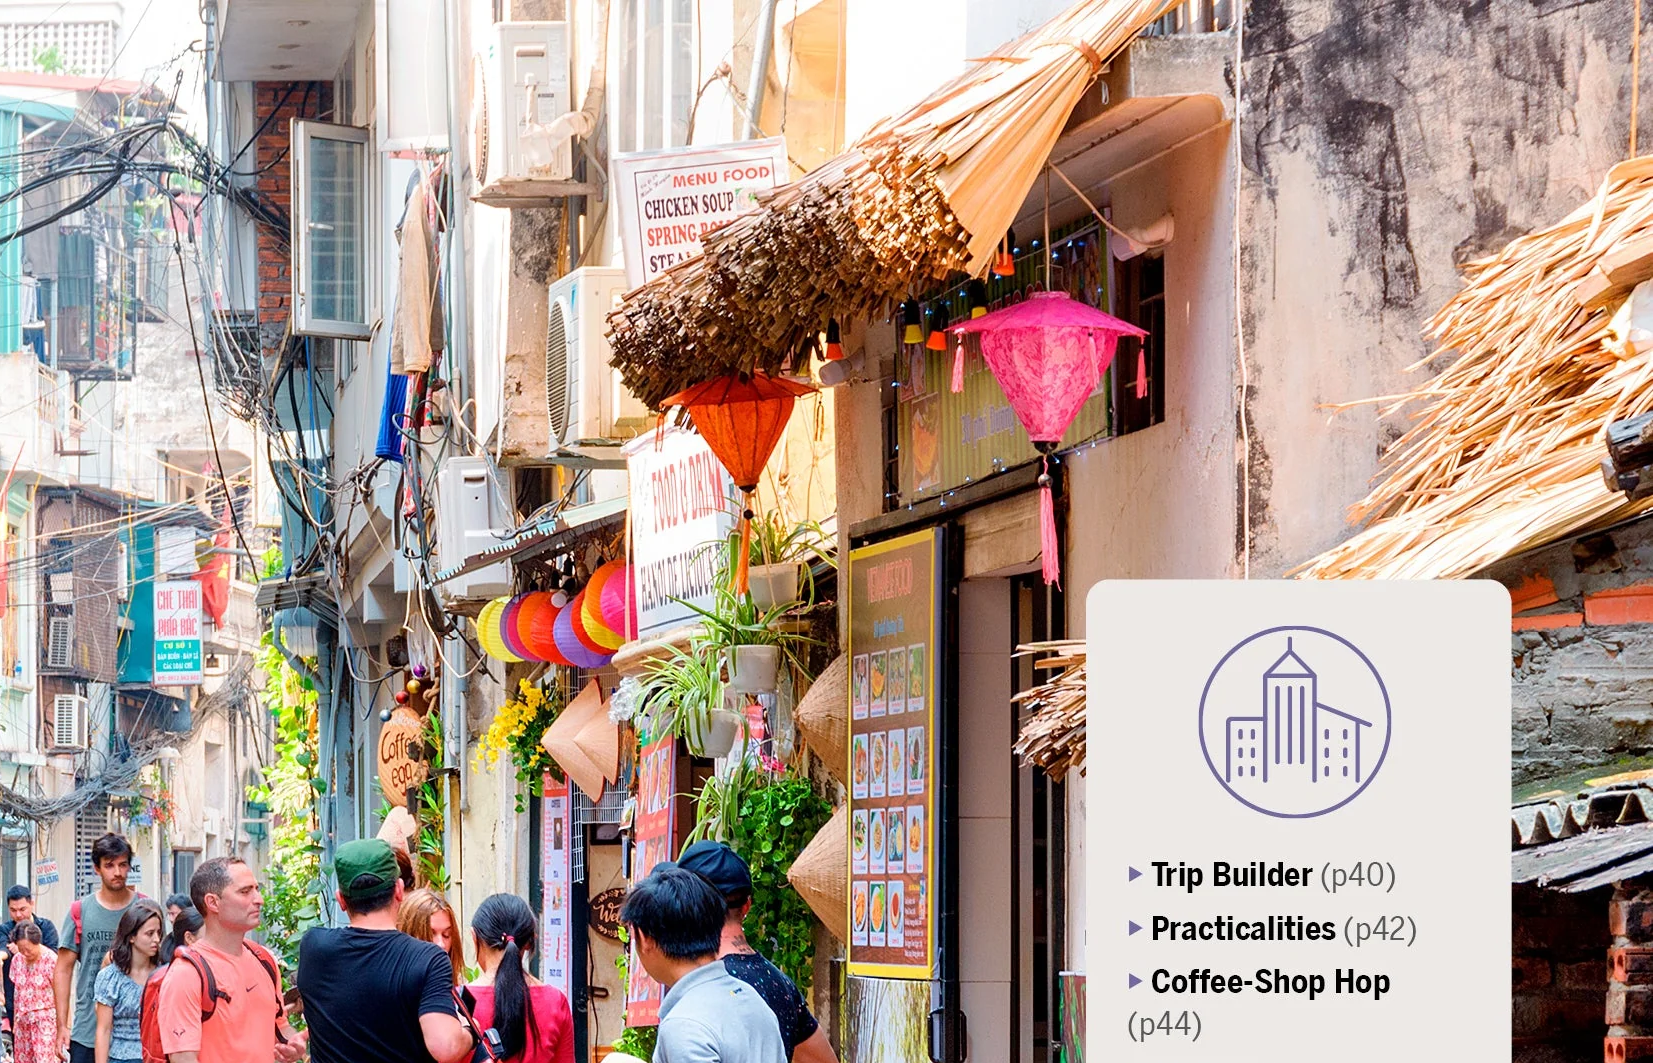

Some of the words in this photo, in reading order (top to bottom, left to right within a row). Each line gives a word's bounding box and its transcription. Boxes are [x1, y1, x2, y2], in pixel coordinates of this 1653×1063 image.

[673, 171, 718, 188] MENU
[723, 166, 770, 183] FOOD
[645, 195, 699, 220] CHICKEN
[702, 191, 734, 214] SOUP
[647, 223, 697, 247] SPRING
[652, 464, 678, 534] FOOD
[381, 730, 416, 764] Coffe
[593, 902, 623, 923] Wel
